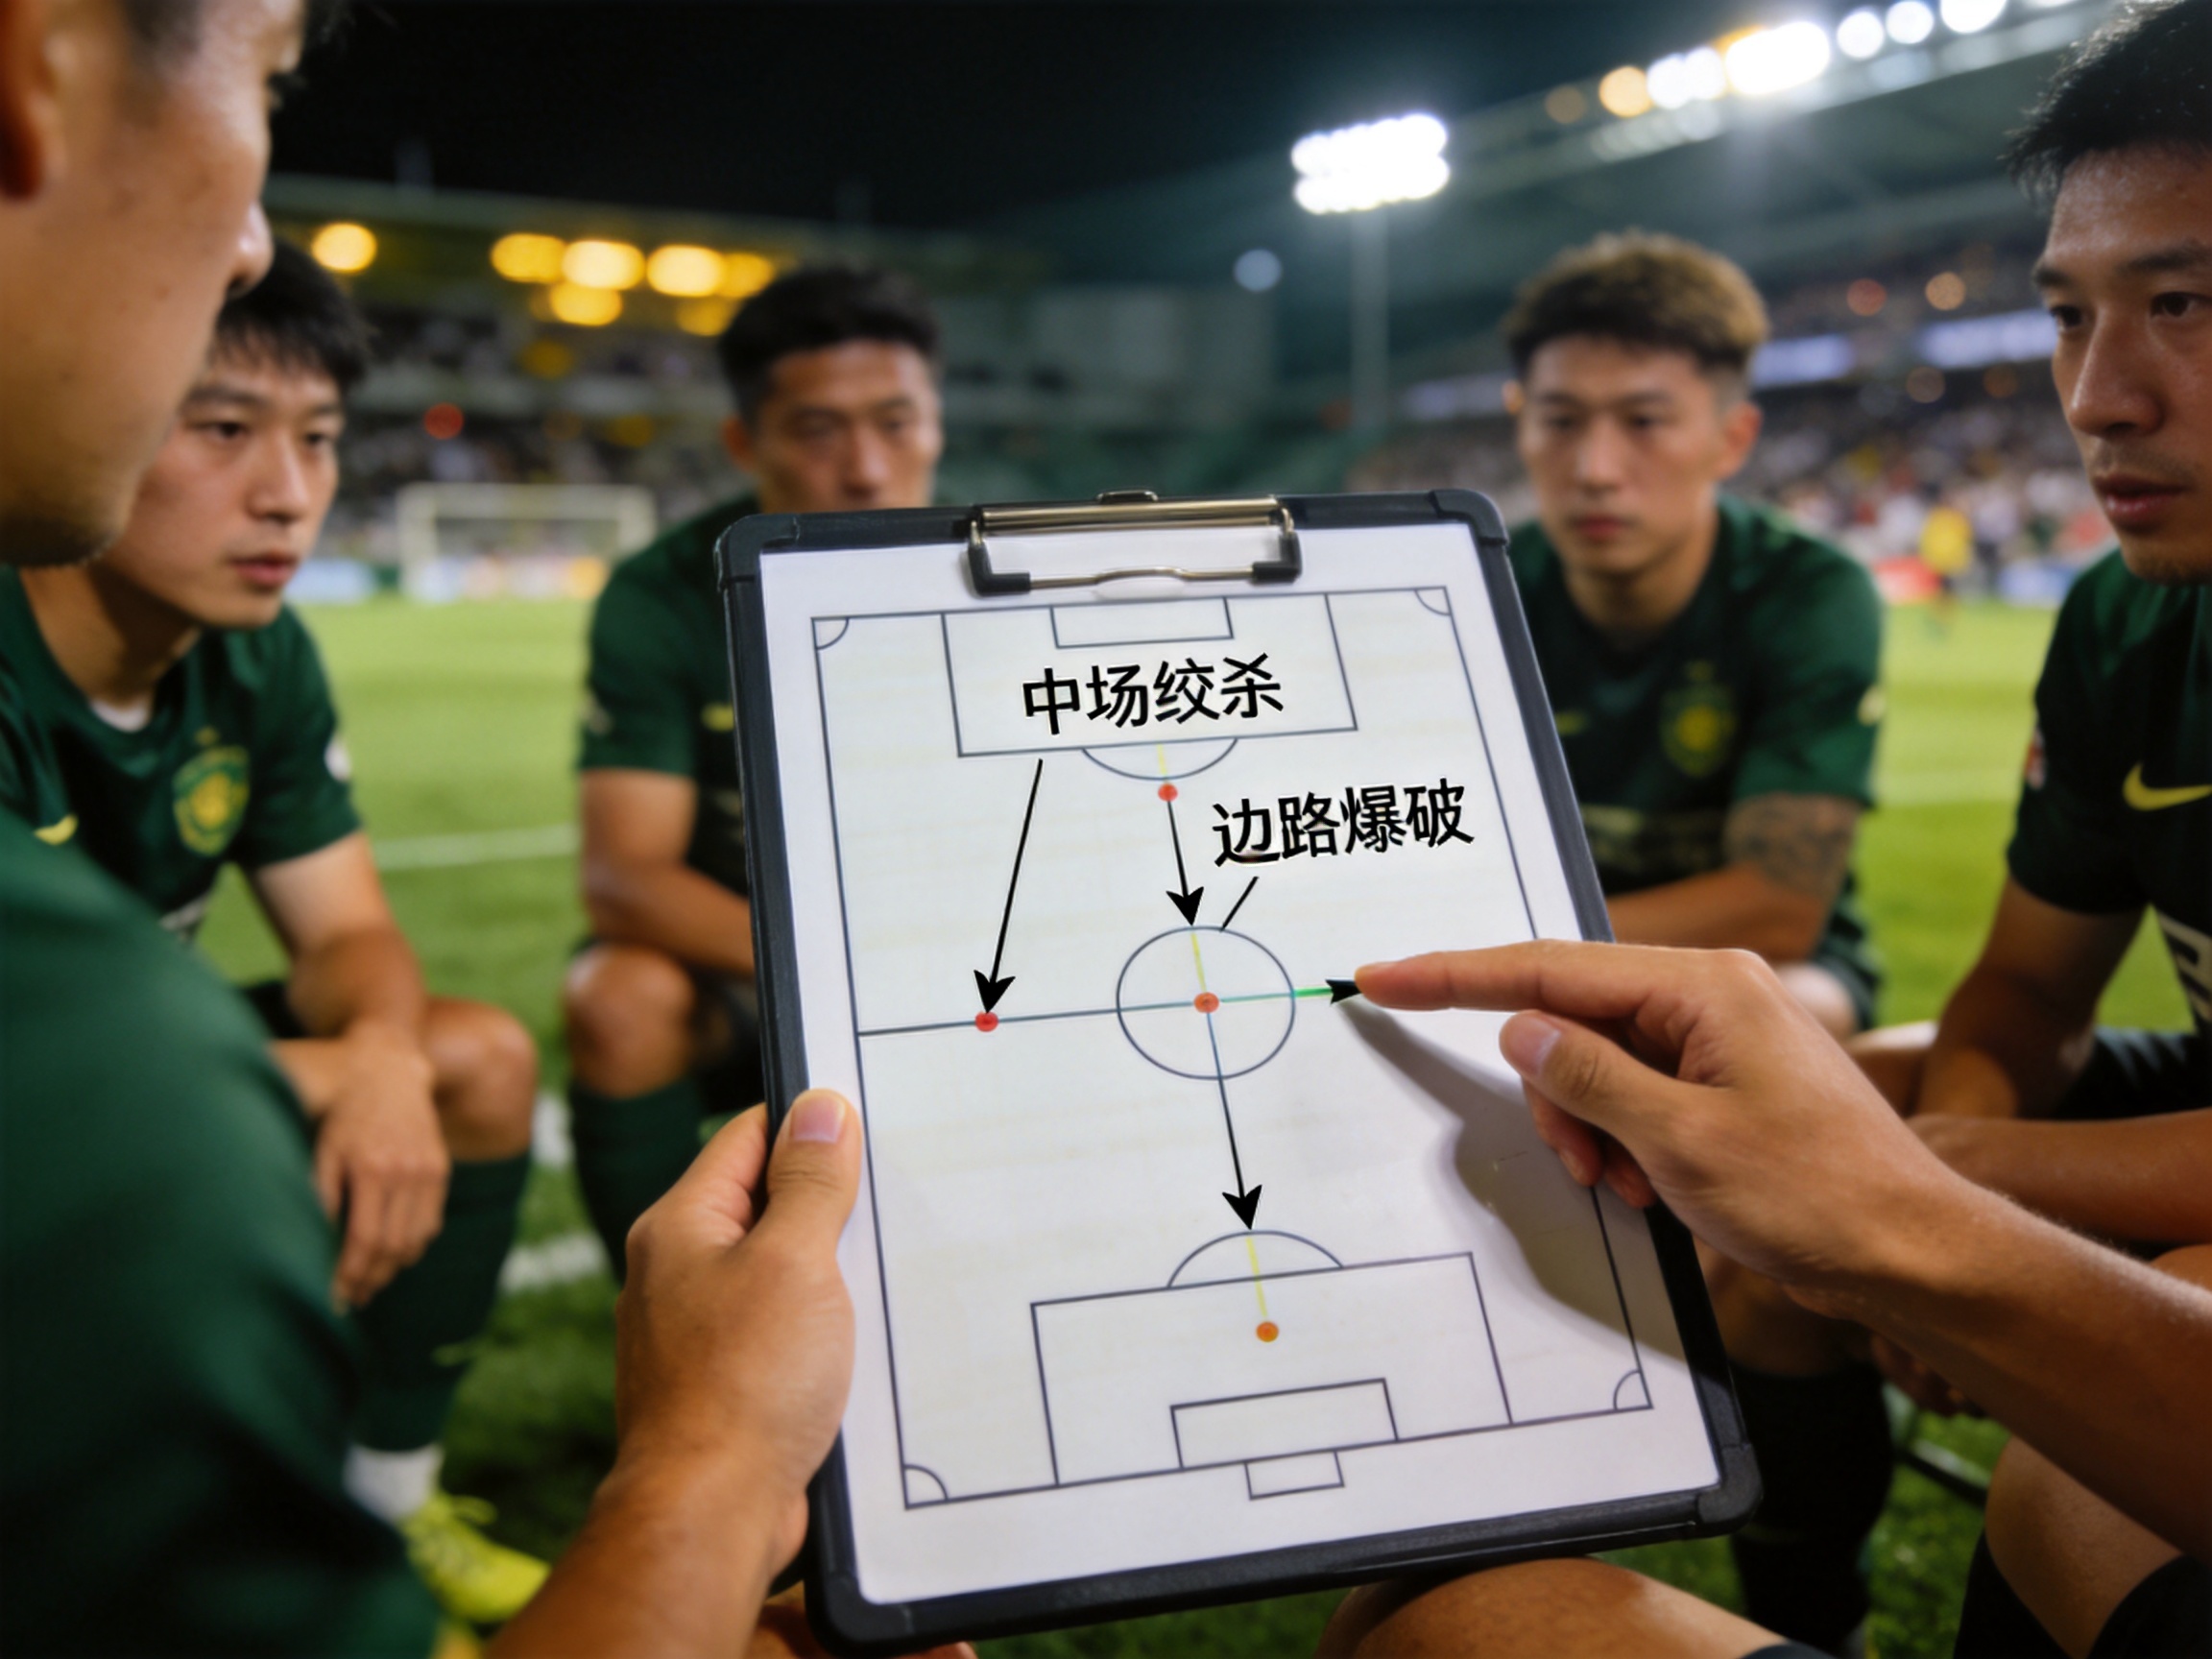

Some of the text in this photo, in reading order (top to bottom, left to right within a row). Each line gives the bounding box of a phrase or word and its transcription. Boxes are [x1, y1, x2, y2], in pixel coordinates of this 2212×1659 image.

[1022, 653, 1284, 735] 中场绞杀
[1212, 778, 1475, 867] 边路爆破
